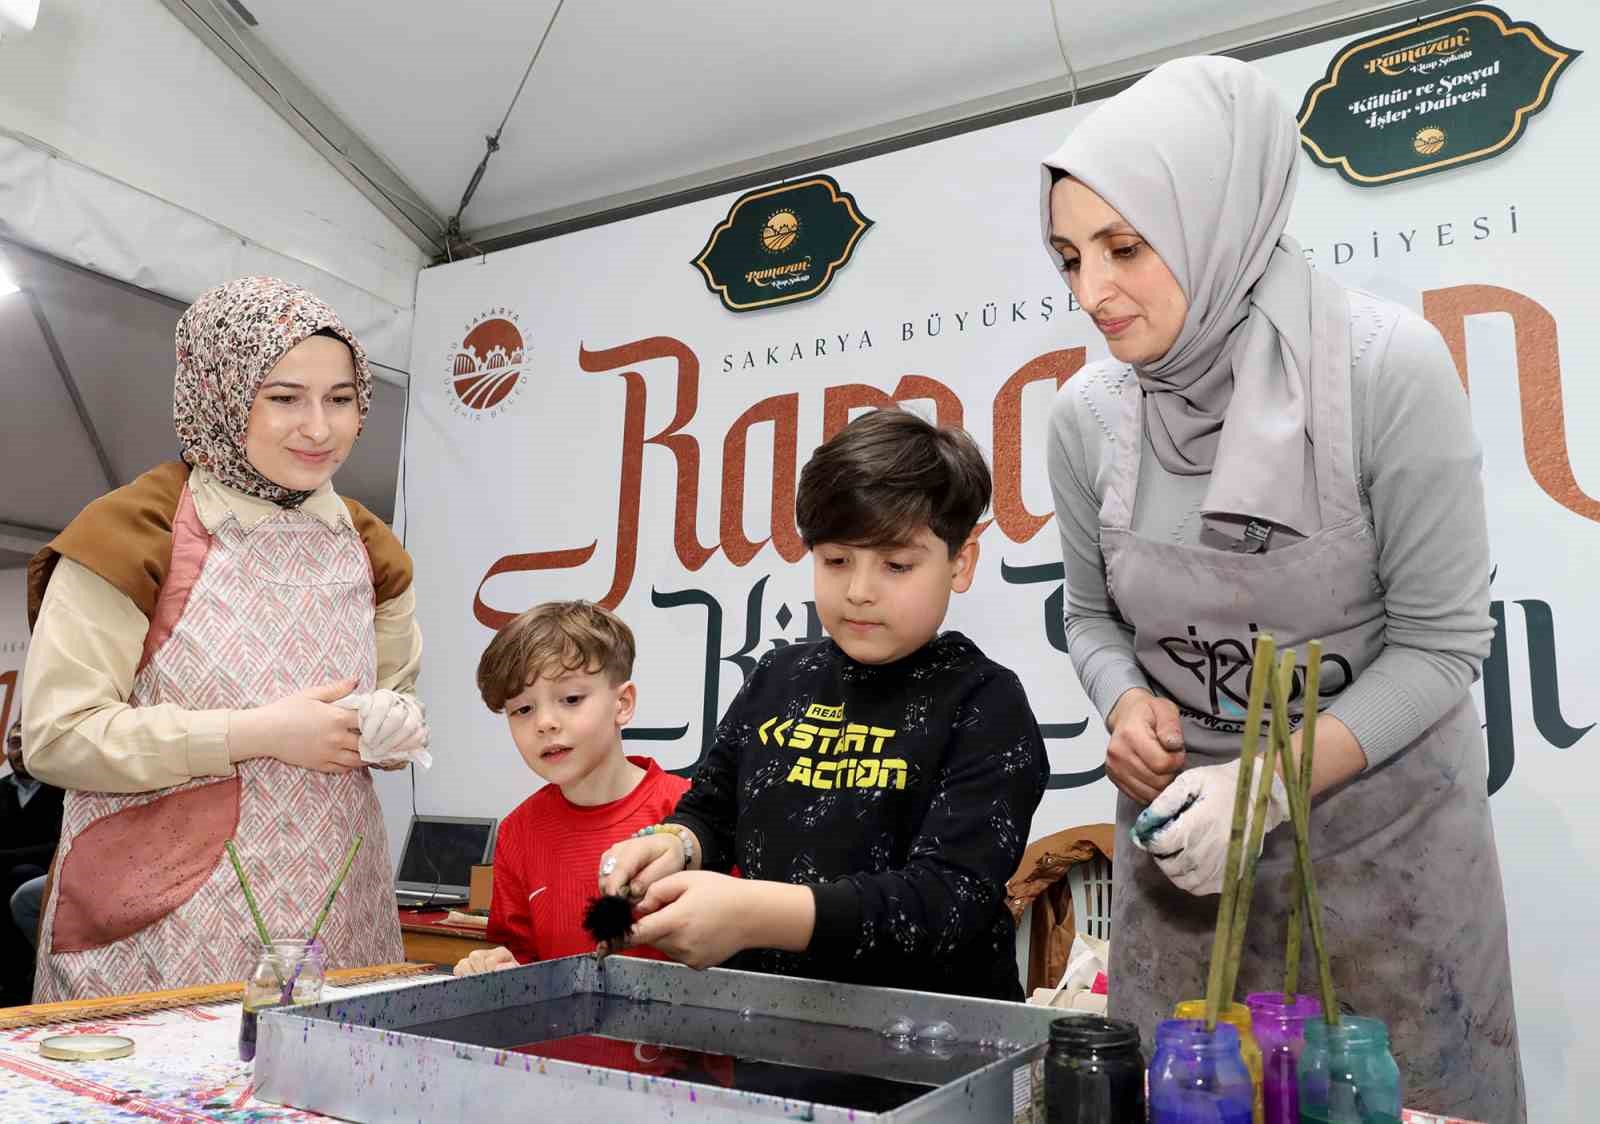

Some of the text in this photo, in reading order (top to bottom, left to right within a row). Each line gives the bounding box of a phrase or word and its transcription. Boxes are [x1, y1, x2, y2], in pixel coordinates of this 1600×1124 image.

[1348, 87, 1413, 115] Kültür
[1364, 82, 1488, 129] İşler Dairesi
[722, 330, 873, 373] SAKARYA
[788, 721, 897, 756] START
[786, 756, 908, 790] ACTION
